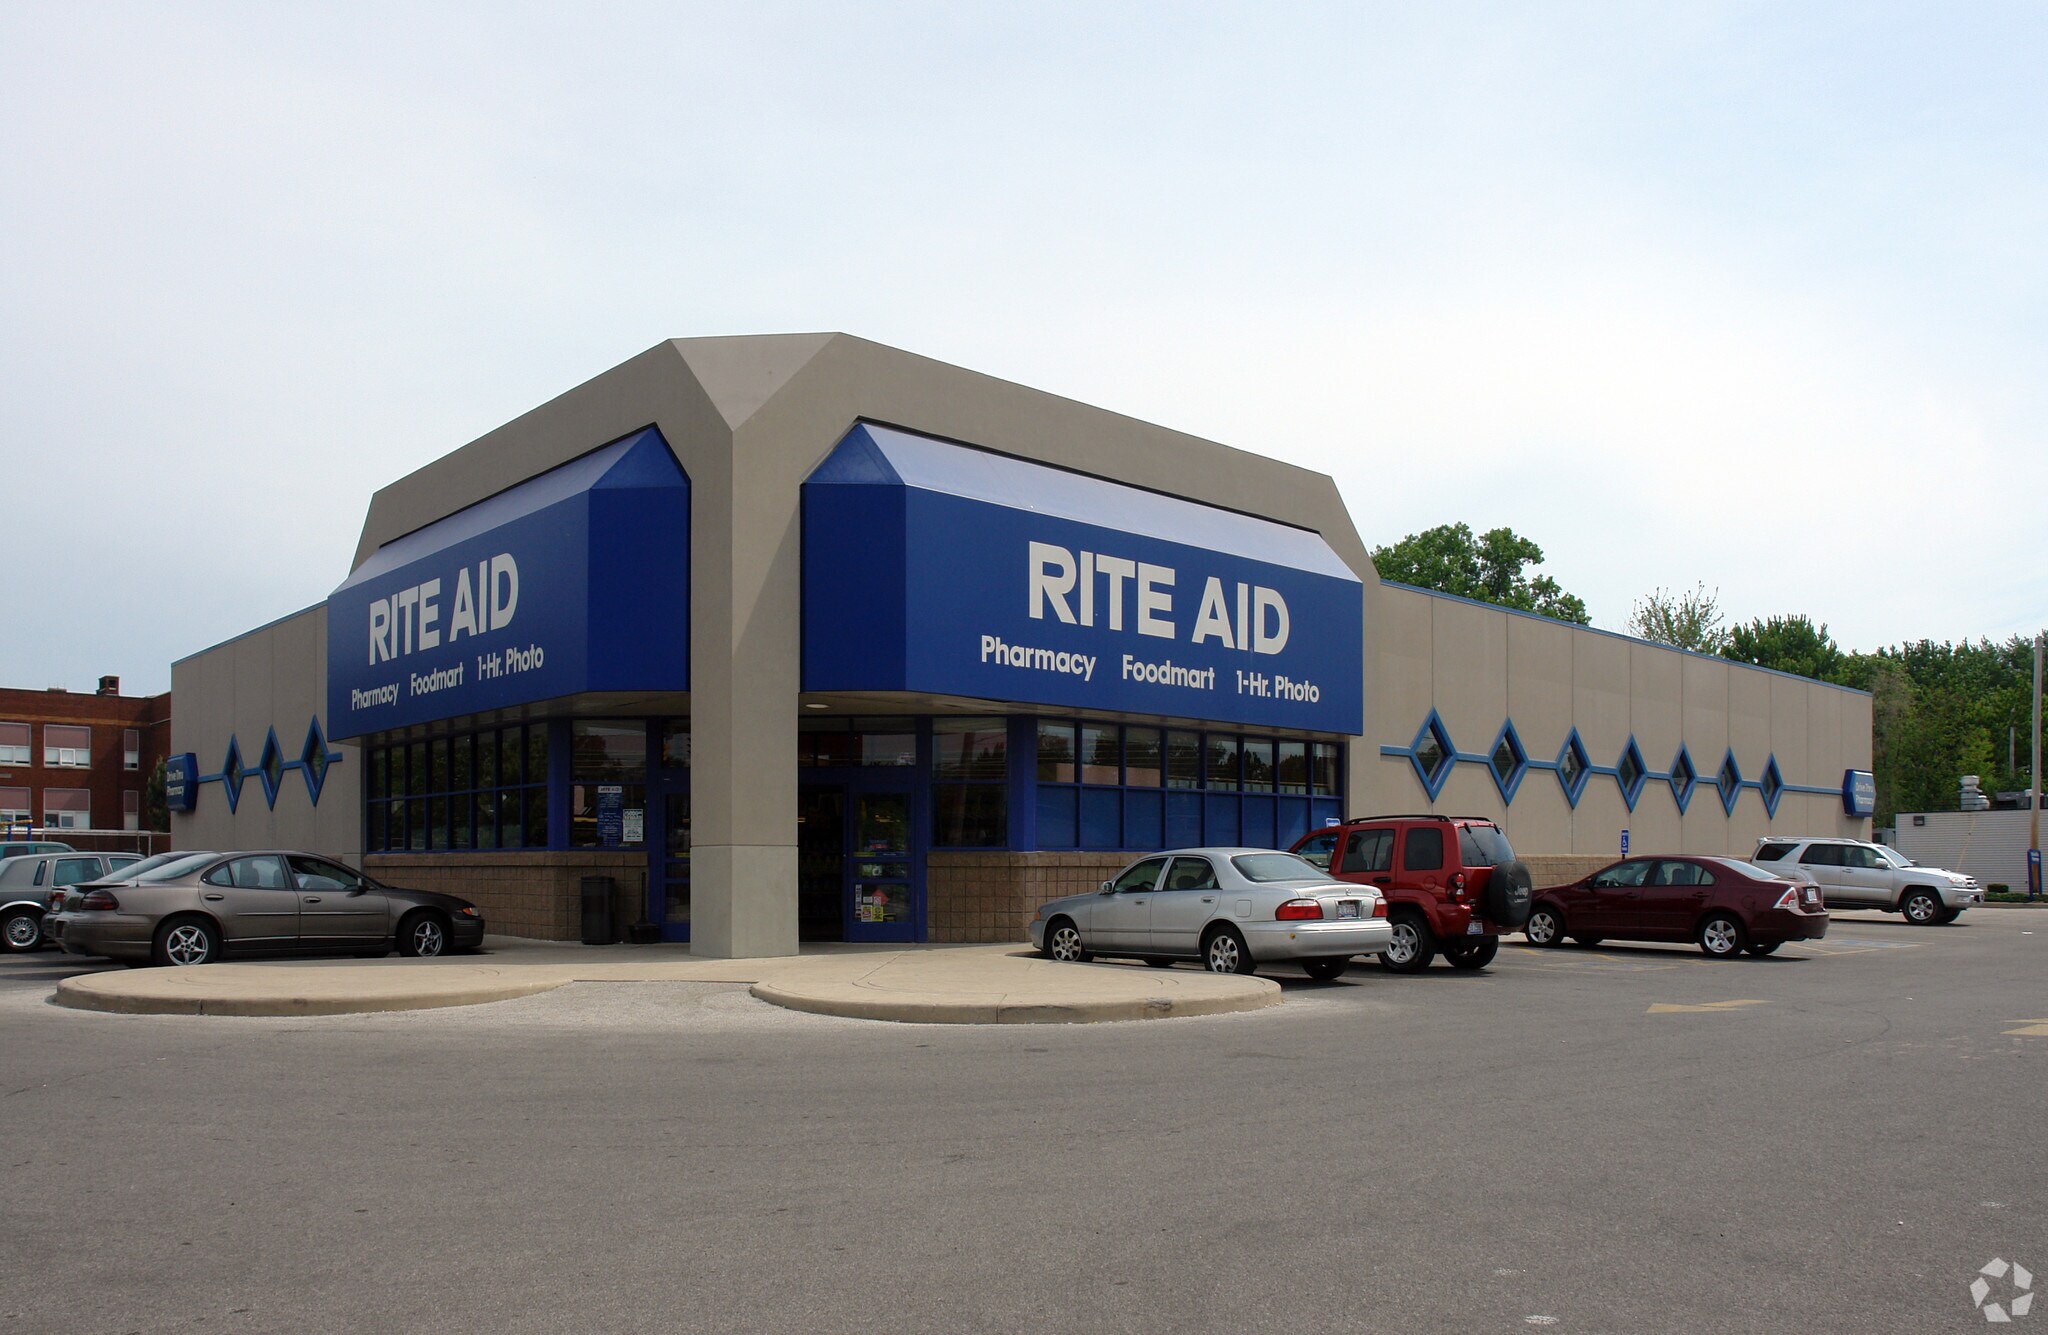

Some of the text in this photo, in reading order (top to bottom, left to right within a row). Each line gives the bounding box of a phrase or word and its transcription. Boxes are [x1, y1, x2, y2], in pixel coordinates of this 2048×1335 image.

[369, 552, 518, 665] RITE AID
[1029, 541, 1289, 655] RITE AID
[352, 643, 544, 711] Pharmacy Foodmart 1-Hr. Photo
[982, 635, 1319, 703] Pharmacy Foodmart 1-Hr. Photo
[1514, 884, 1529, 898] Jeep
